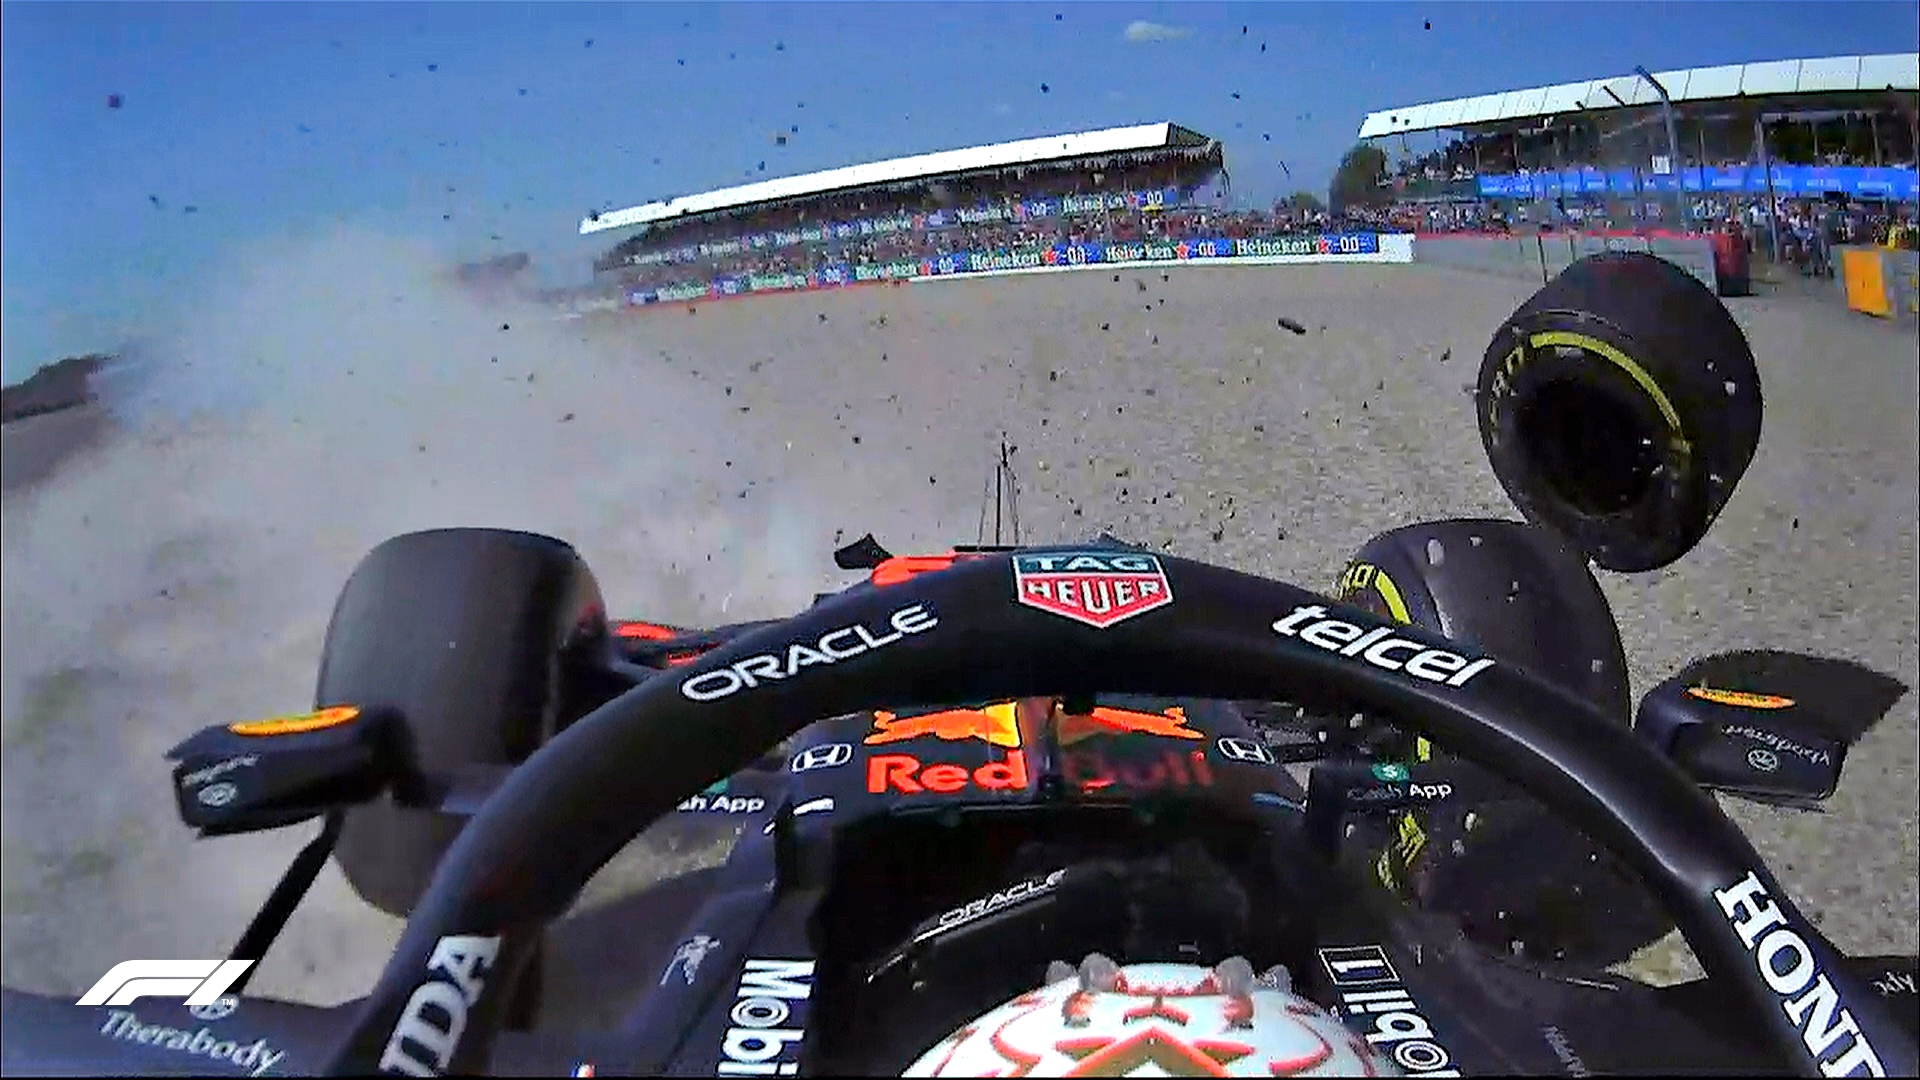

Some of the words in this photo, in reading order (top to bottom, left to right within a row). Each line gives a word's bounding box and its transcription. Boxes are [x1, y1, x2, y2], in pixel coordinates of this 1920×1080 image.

[1236, 238, 1311, 255] Heineken
[971, 251, 1040, 270] Heineken
[1024, 556, 1149, 571] TAG
[1027, 579, 1160, 614] HEUER
[682, 602, 939, 701] ORACLE
[1272, 605, 1497, 687] telcel
[867, 750, 1029, 795] Red
[710, 795, 766, 813] App
[1409, 783, 1452, 800] App
[1342, 989, 1463, 1077] obil
